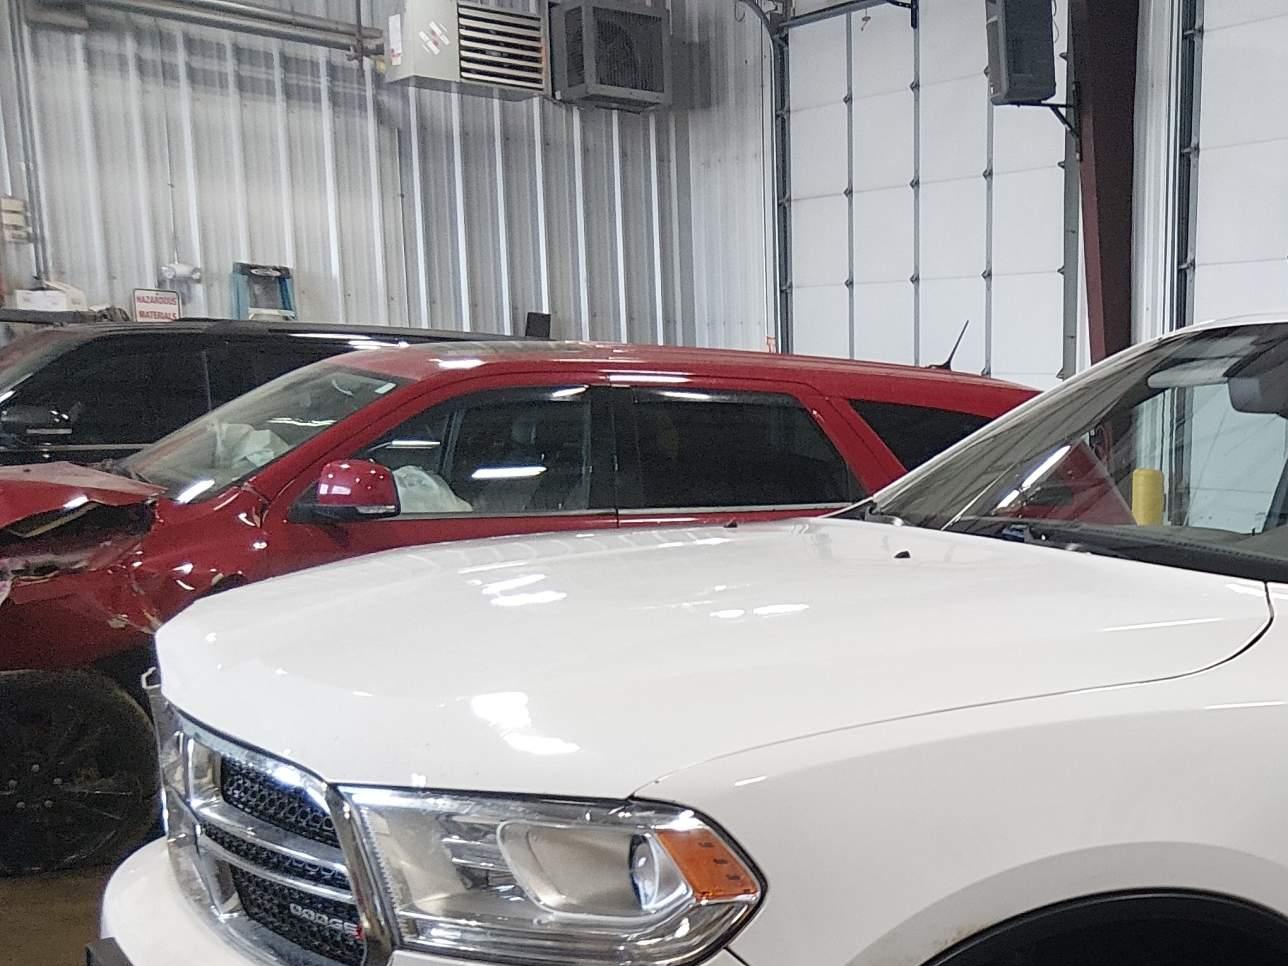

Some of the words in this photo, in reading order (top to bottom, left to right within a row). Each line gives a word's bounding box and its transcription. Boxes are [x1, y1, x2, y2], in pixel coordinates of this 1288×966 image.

[136, 295, 177, 305] HAZARDOUS
[138, 310, 177, 321] MATERIALS
[289, 903, 359, 937] DODGE
